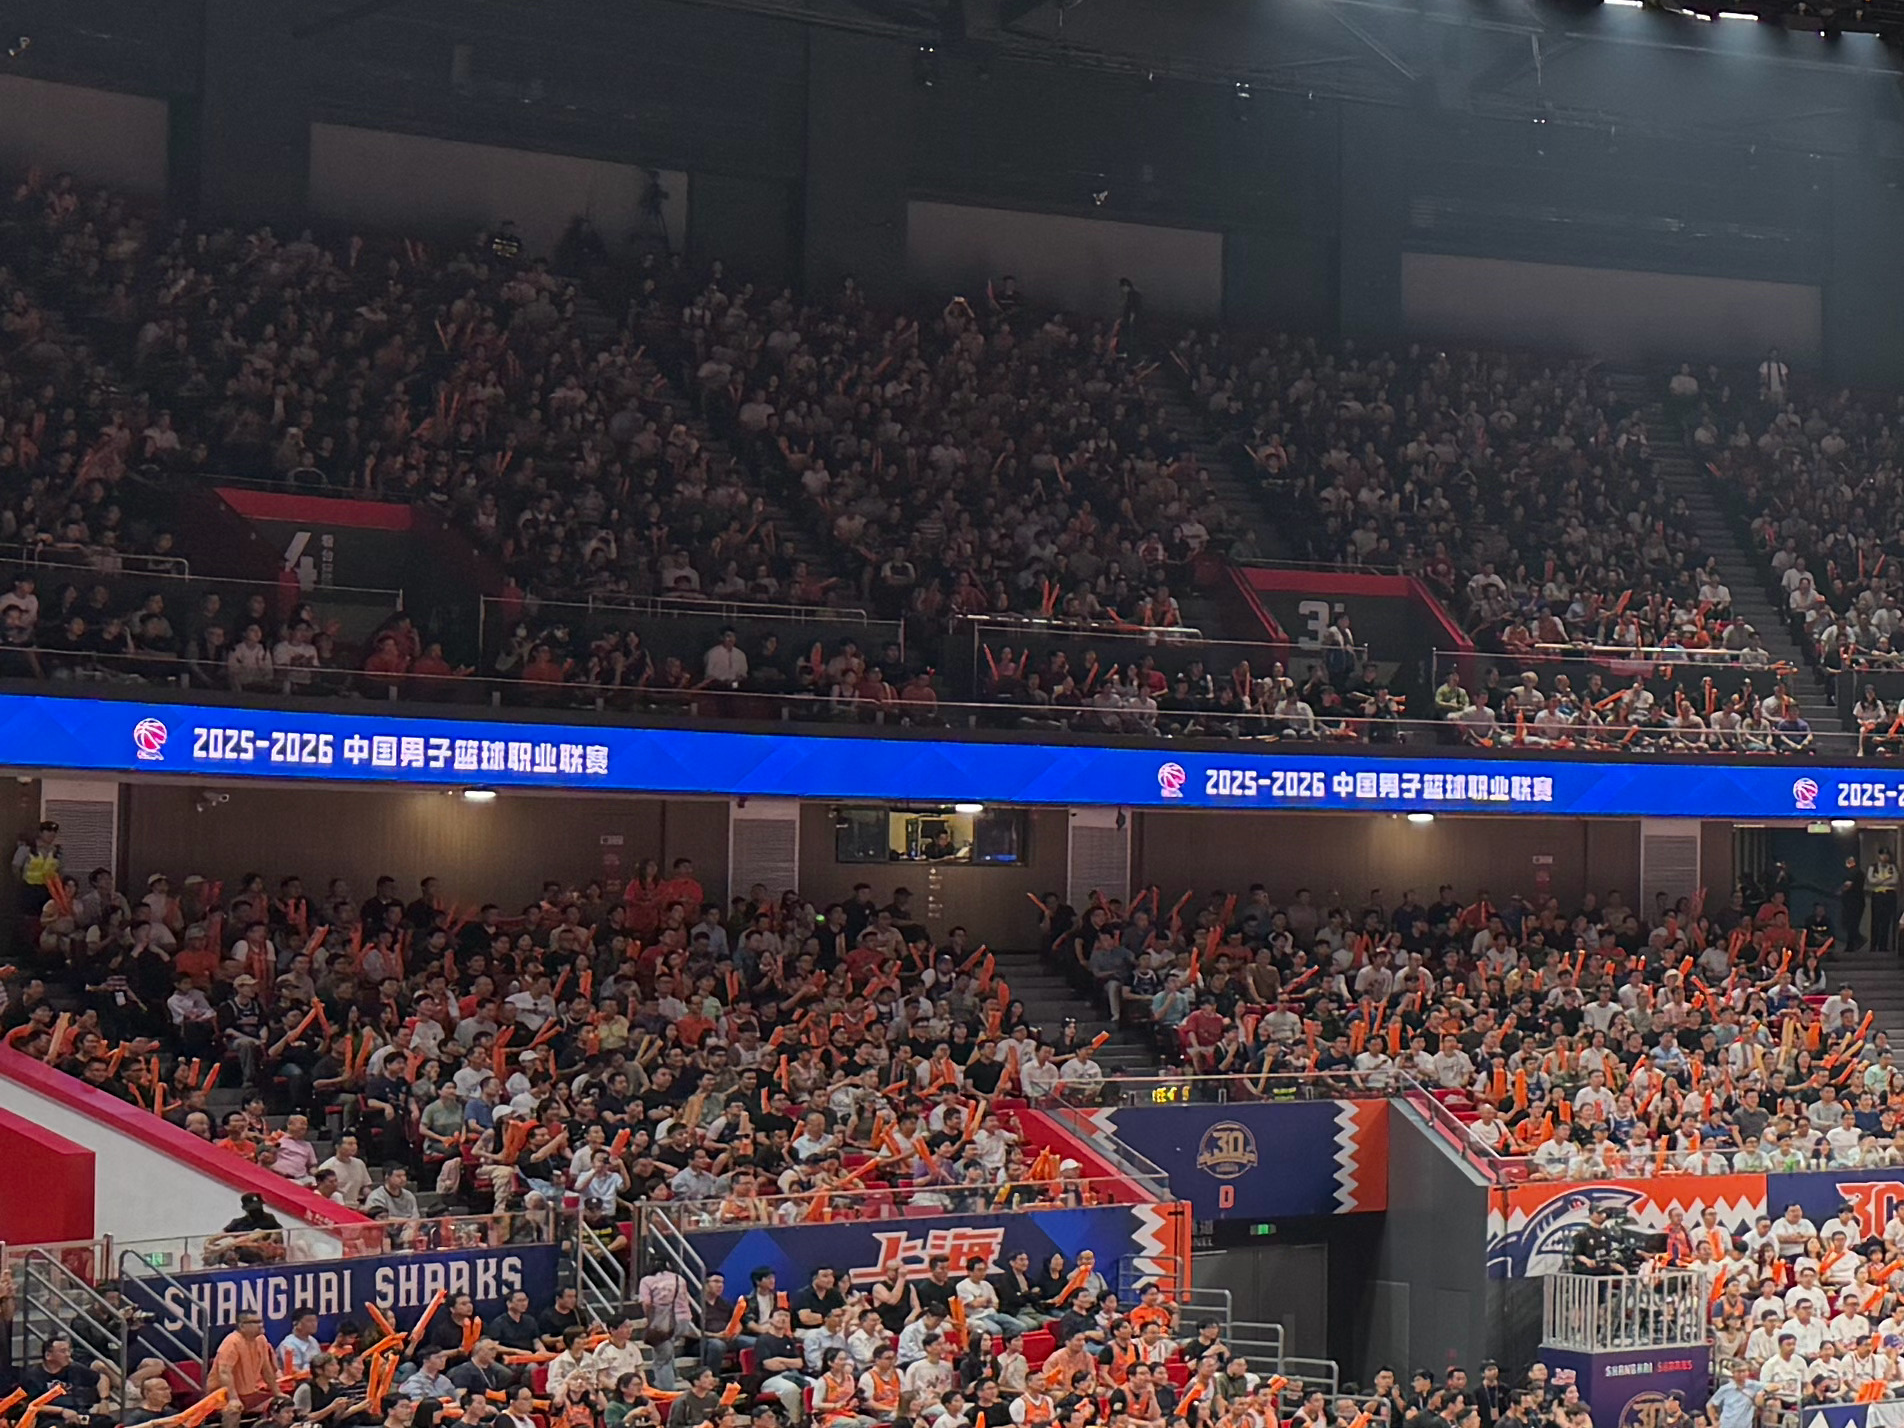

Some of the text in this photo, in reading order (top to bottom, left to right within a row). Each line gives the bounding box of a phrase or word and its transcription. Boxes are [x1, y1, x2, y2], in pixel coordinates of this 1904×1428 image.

[284, 532, 317, 592] 4
[1299, 600, 1328, 651] 3
[192, 727, 609, 776] 2025-2026 中国男子篮球职业联赛
[1204, 766, 1554, 803] 2025-2026 中国男子篮球职业联赛
[1218, 1187, 1234, 1209] D
[850, 1226, 1005, 1282] 上海
[163, 1254, 525, 1328] SHANGHAI SHARKS
